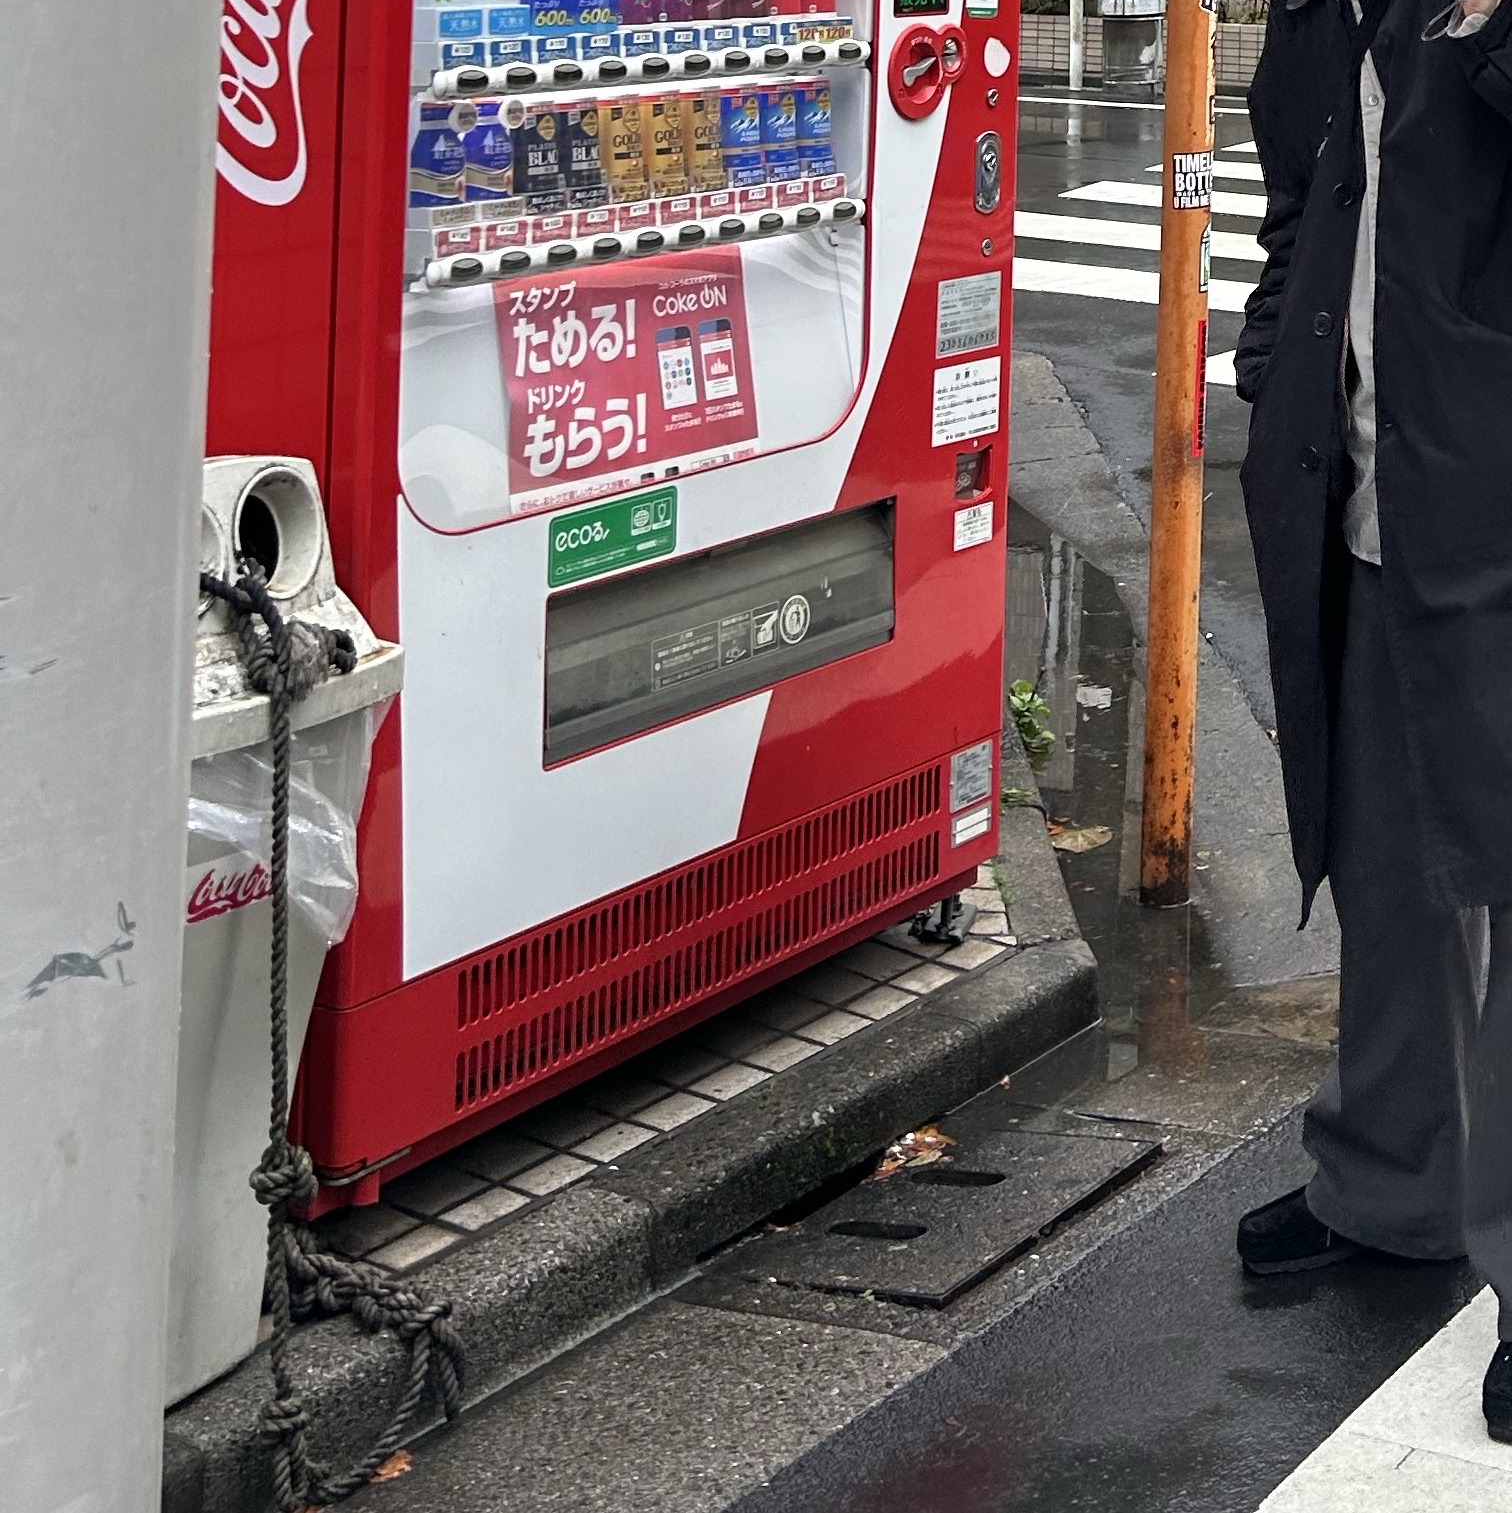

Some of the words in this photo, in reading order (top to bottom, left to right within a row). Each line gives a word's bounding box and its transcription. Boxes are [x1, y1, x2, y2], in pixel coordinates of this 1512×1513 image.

[510, 280, 577, 315] スタンプ
[652, 292, 698, 317] Coke
[700, 284, 728, 309] ON
[513, 298, 636, 377] ためる!
[527, 379, 586, 414] ドリンク
[523, 392, 647, 478] もらう!
